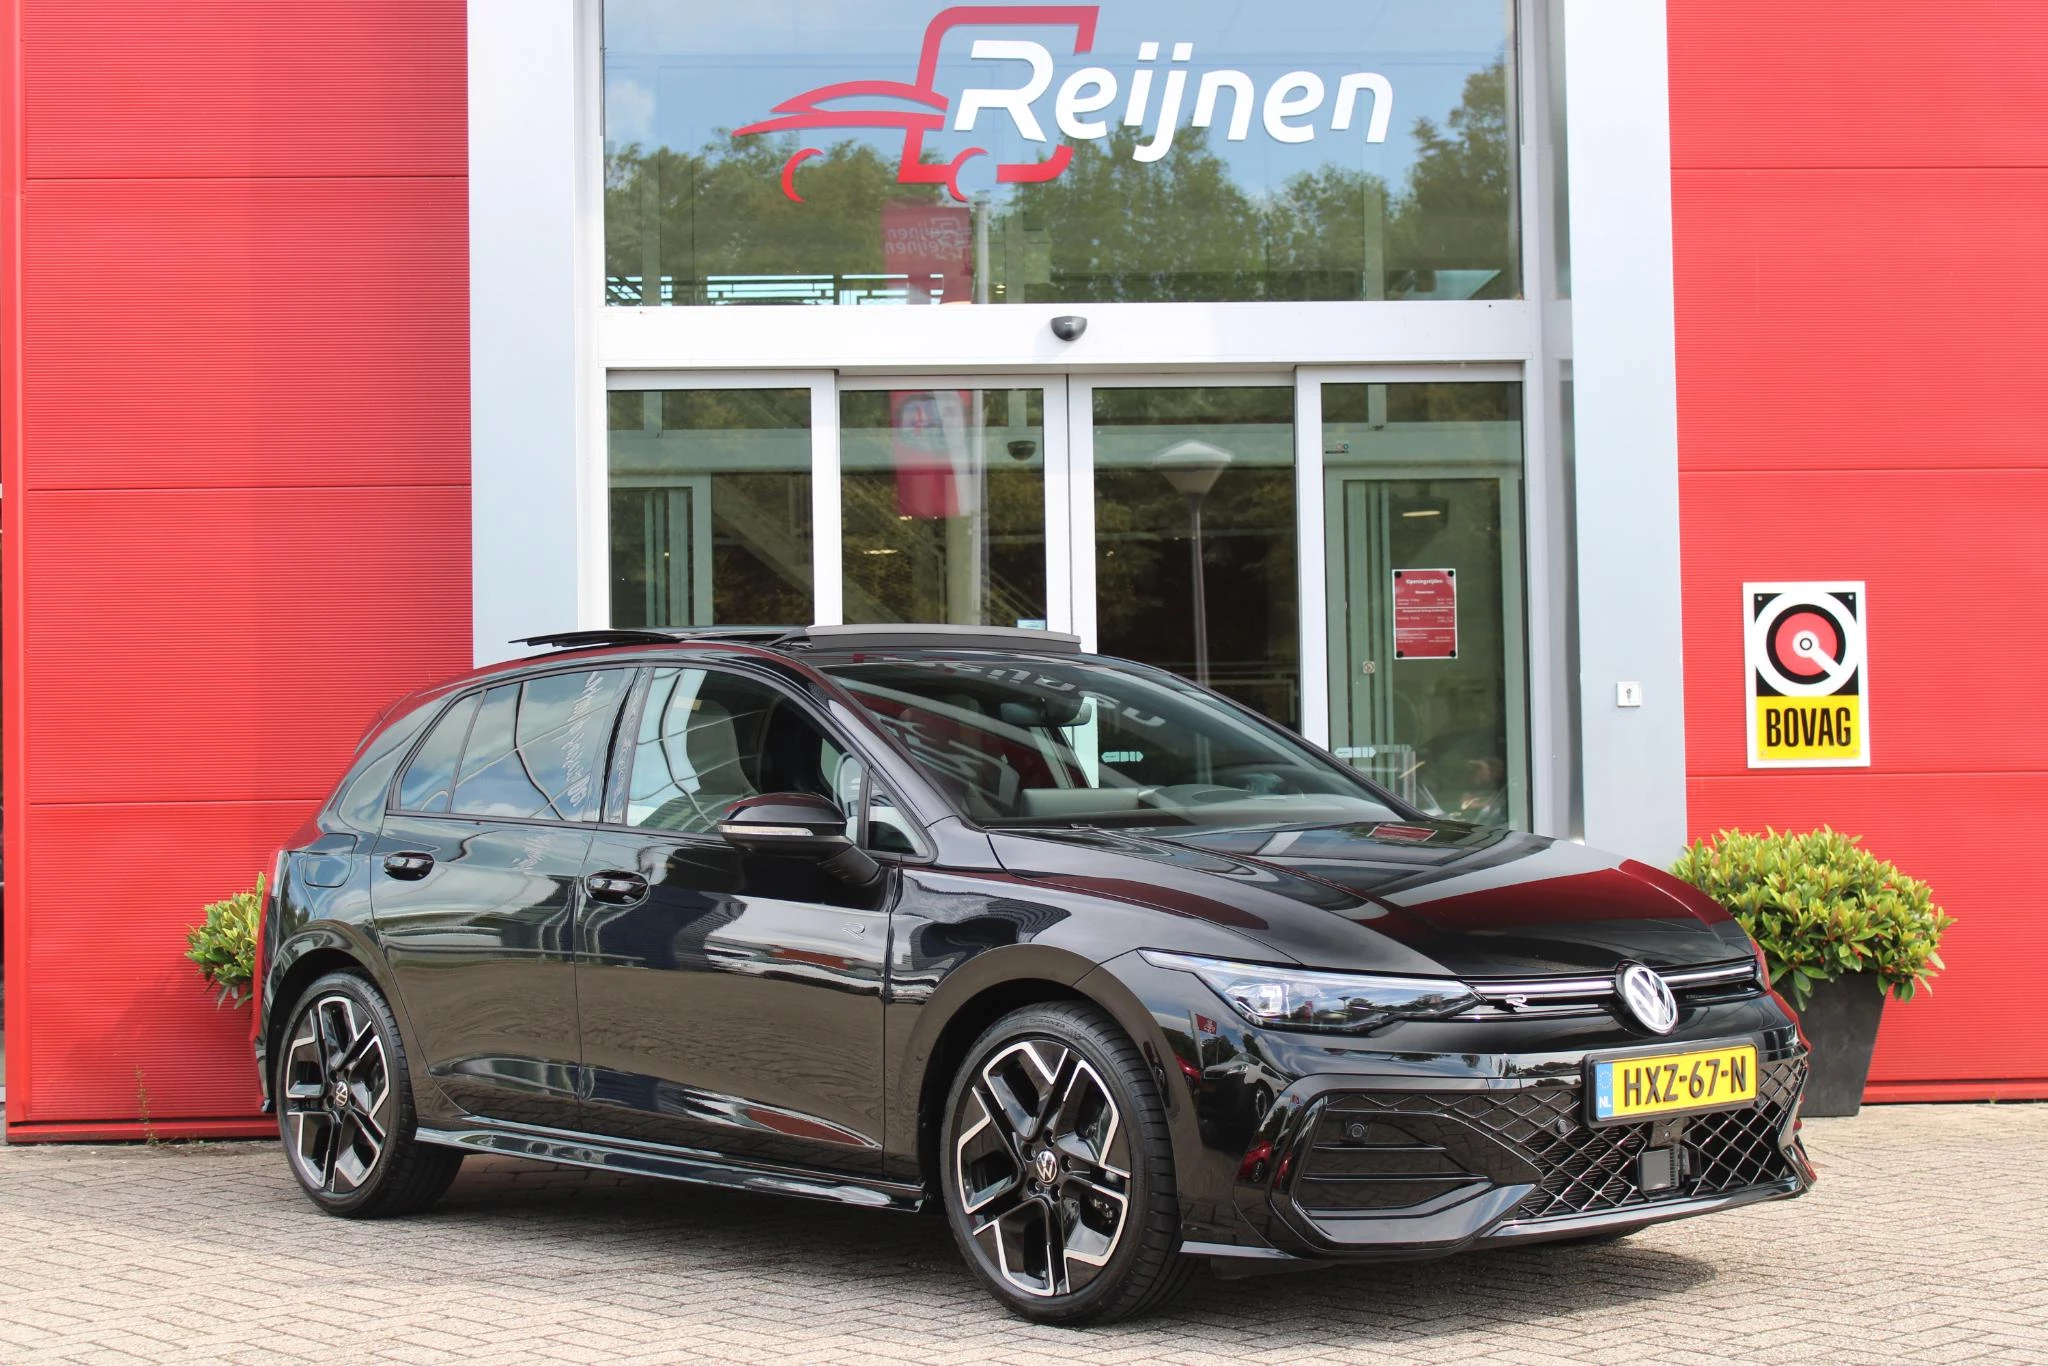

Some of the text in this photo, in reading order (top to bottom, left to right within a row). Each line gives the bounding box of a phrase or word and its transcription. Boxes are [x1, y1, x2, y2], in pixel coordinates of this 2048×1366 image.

[953, 39, 1394, 163] Reijnen
[1766, 707, 1852, 748] BOVAG
[1599, 1056, 1746, 1108] NL HXZ-67-N
